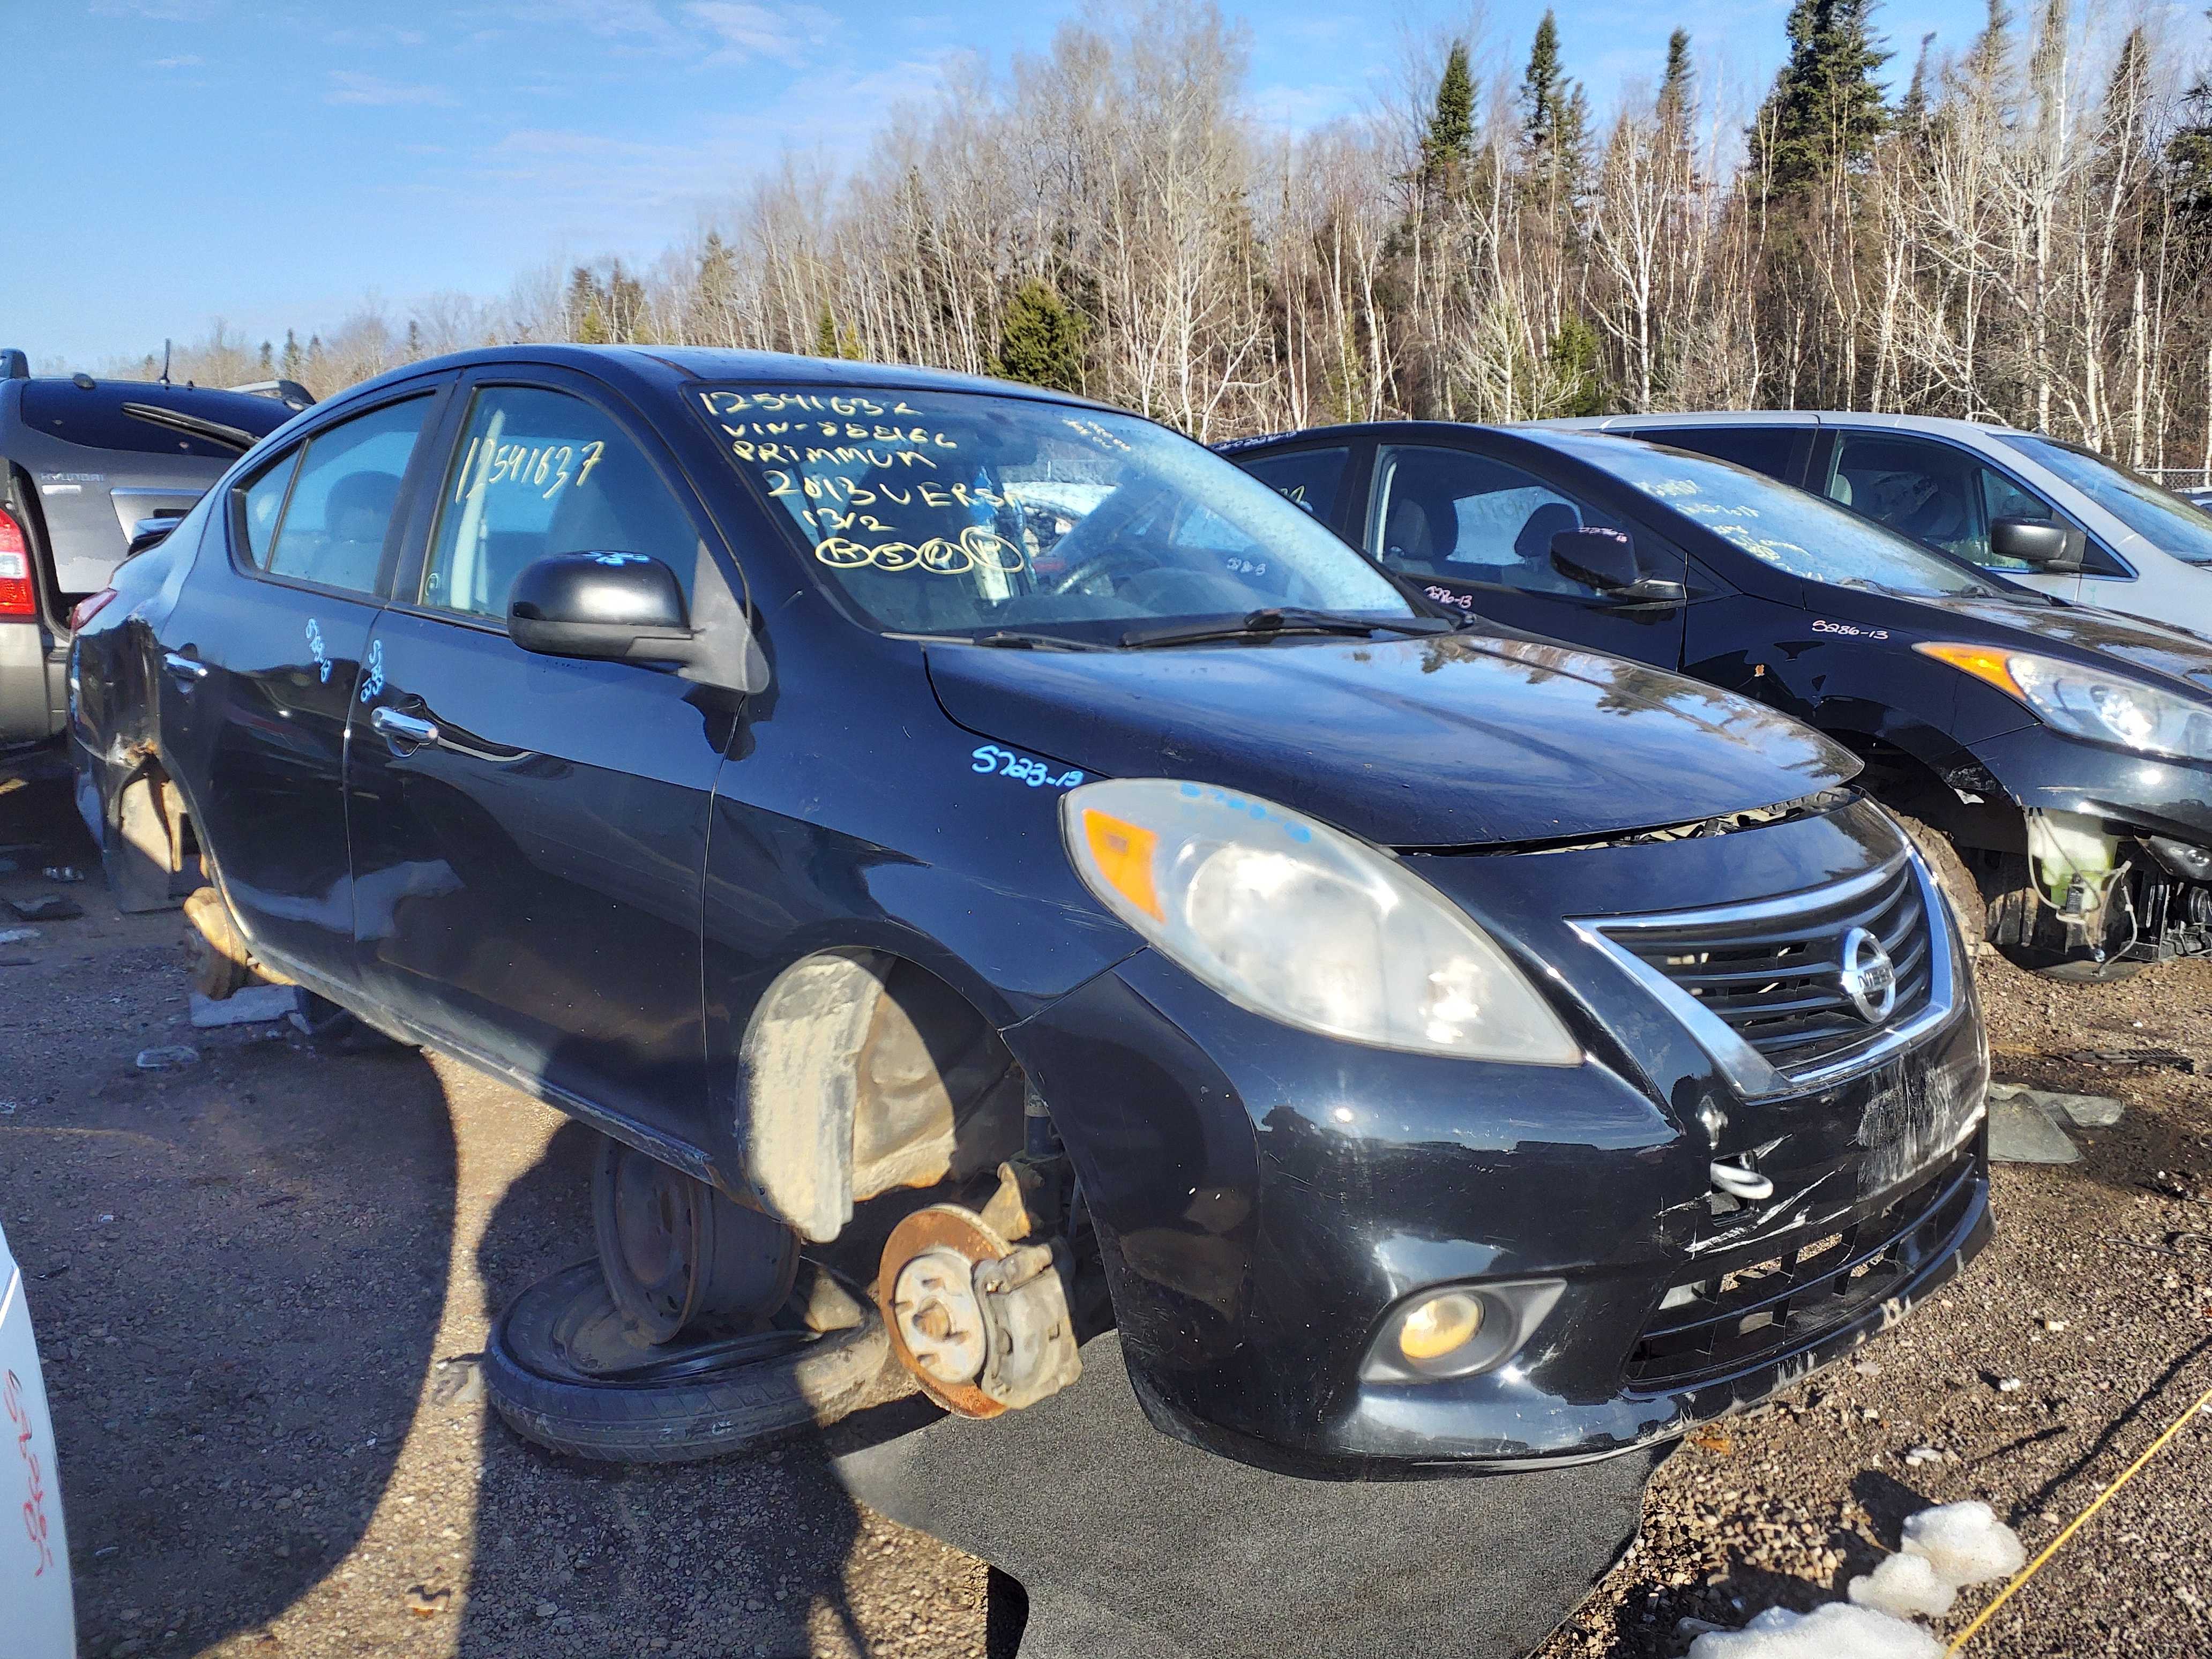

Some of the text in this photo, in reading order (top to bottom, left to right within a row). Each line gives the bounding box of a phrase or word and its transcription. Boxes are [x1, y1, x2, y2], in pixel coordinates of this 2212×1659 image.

[41, 472, 104, 482] HYUNDAI
[763, 469, 877, 506] 2013
[1811, 620, 1889, 640] S286-13
[971, 744, 1085, 787] S723-13
